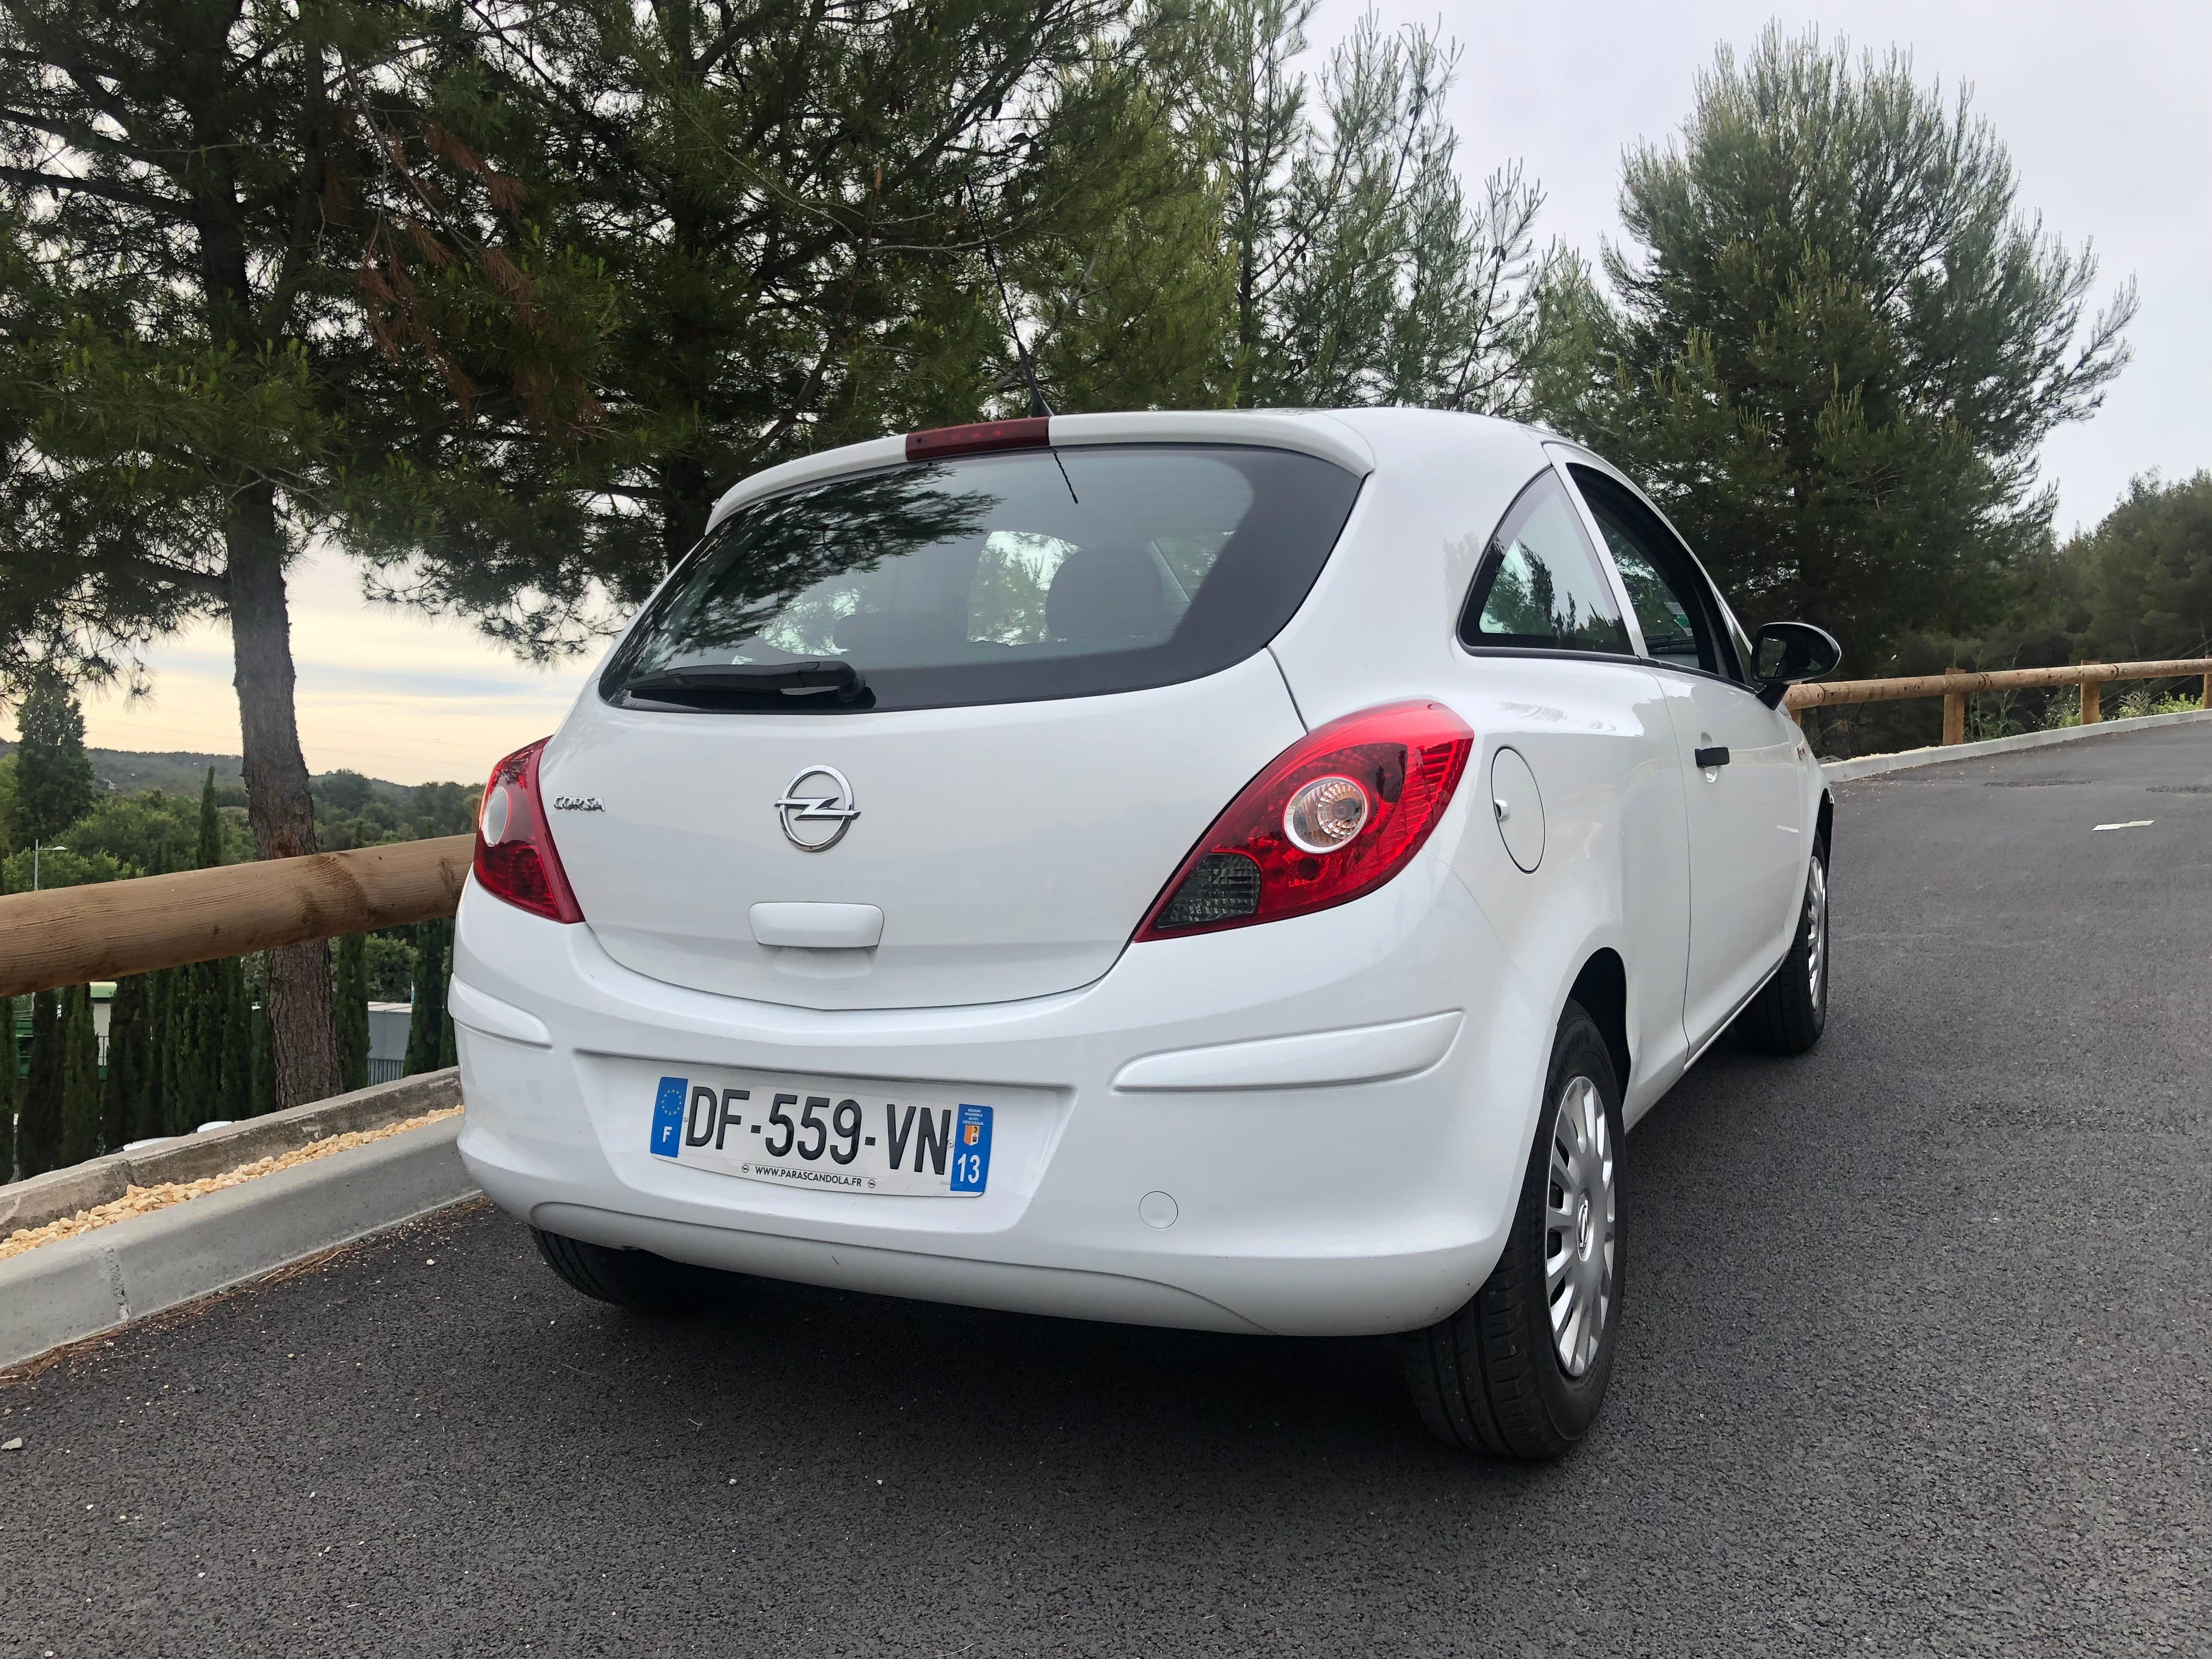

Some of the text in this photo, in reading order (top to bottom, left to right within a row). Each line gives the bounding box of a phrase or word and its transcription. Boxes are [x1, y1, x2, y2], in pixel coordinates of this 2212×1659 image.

[554, 796, 606, 812] CORSA
[662, 1126, 672, 1143] F
[686, 1086, 951, 1176] DF-559-VN
[755, 1166, 862, 1187] WWW.PARASCANDOLA.FR
[957, 1153, 980, 1184] 13
